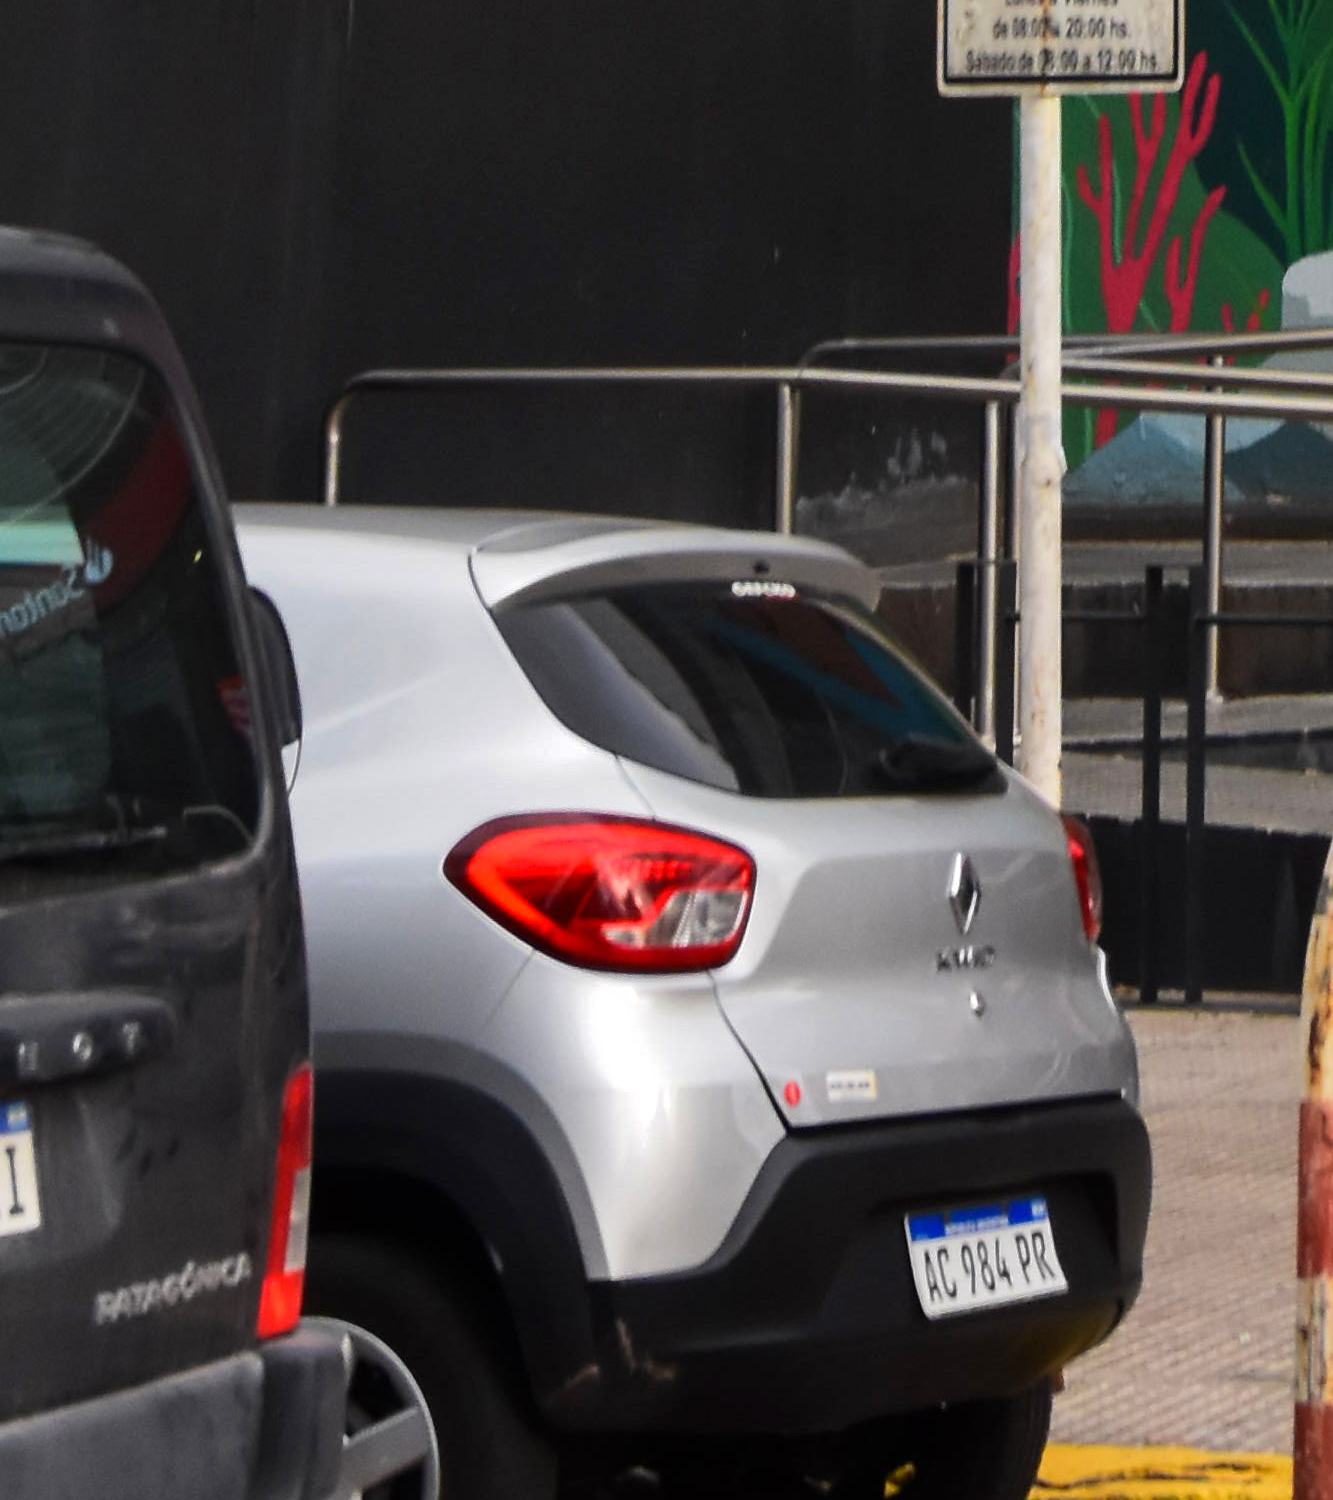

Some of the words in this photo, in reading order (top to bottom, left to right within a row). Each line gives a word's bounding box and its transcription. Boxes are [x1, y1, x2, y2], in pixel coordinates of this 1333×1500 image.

[1065, 16, 1107, 39] 20:00
[923, 1248, 958, 1303] AC
[960, 1238, 1013, 1295] 984
[1014, 1230, 1056, 1284] PR
